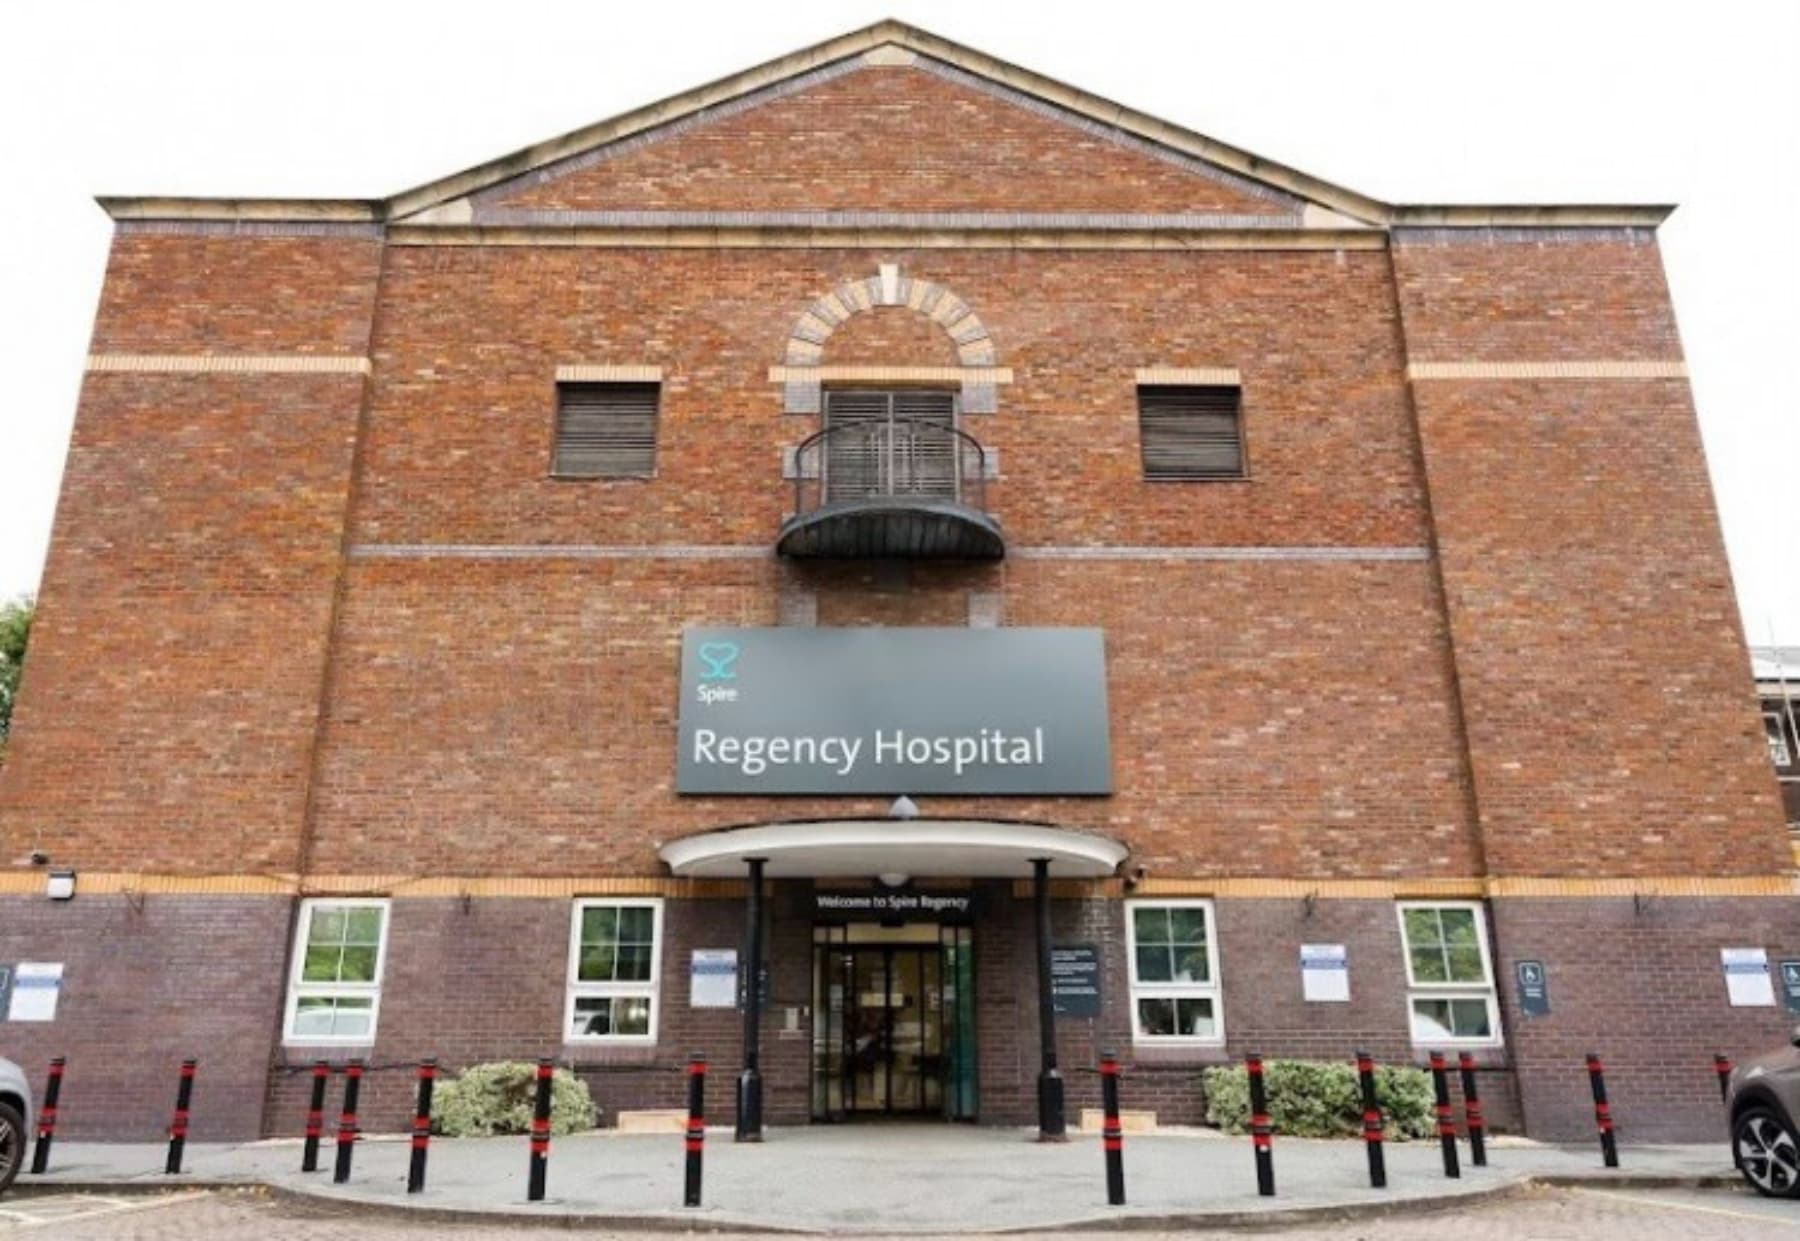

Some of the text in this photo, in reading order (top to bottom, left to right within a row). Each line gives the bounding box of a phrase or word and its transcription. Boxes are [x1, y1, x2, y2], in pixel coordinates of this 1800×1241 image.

[696, 684, 737, 704] Spire
[694, 727, 1044, 774] Regency Hospital
[817, 896, 968, 911] Welcome to Spire Regency
